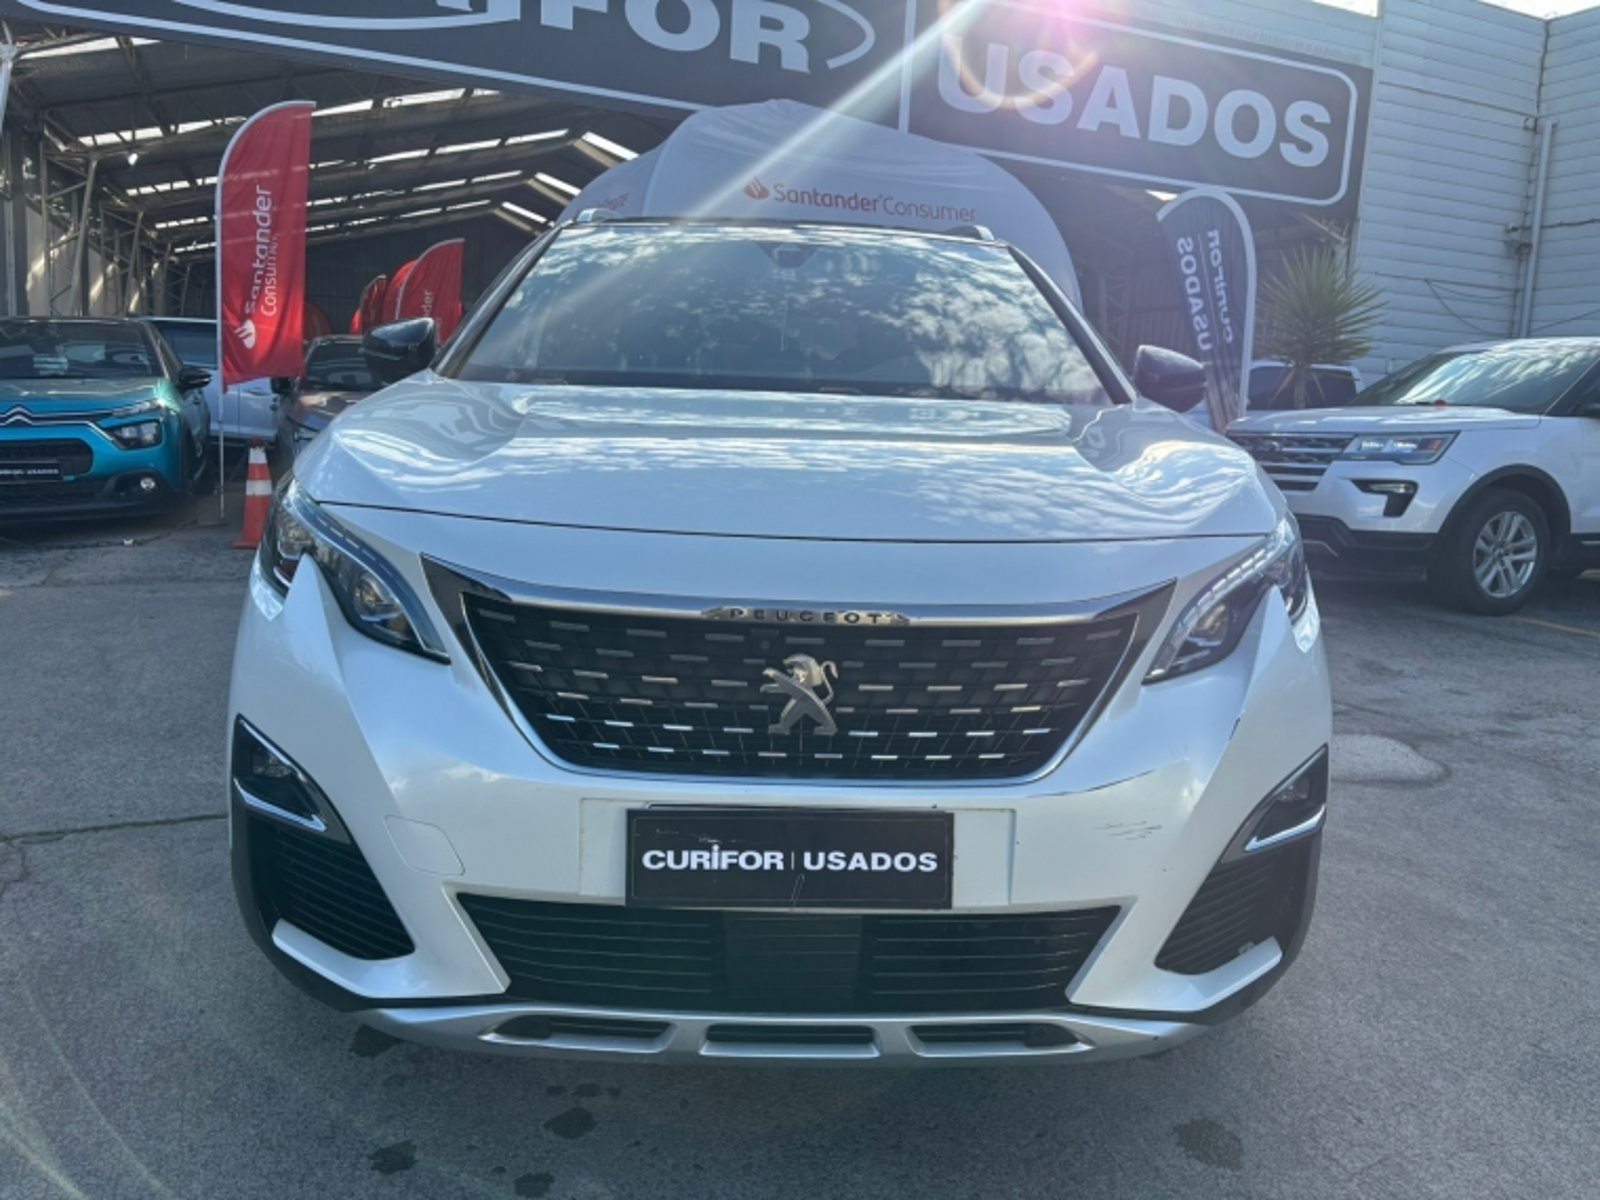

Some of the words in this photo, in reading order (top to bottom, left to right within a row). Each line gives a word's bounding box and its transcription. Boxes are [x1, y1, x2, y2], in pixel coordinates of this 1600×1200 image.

[938, 33, 1332, 168] USADOS
[773, 183, 880, 213] Santander
[882, 196, 976, 223] Consumer
[244, 185, 272, 315] Santander
[730, 608, 882, 625] PEUGEOT
[803, 851, 938, 872] USADOS
